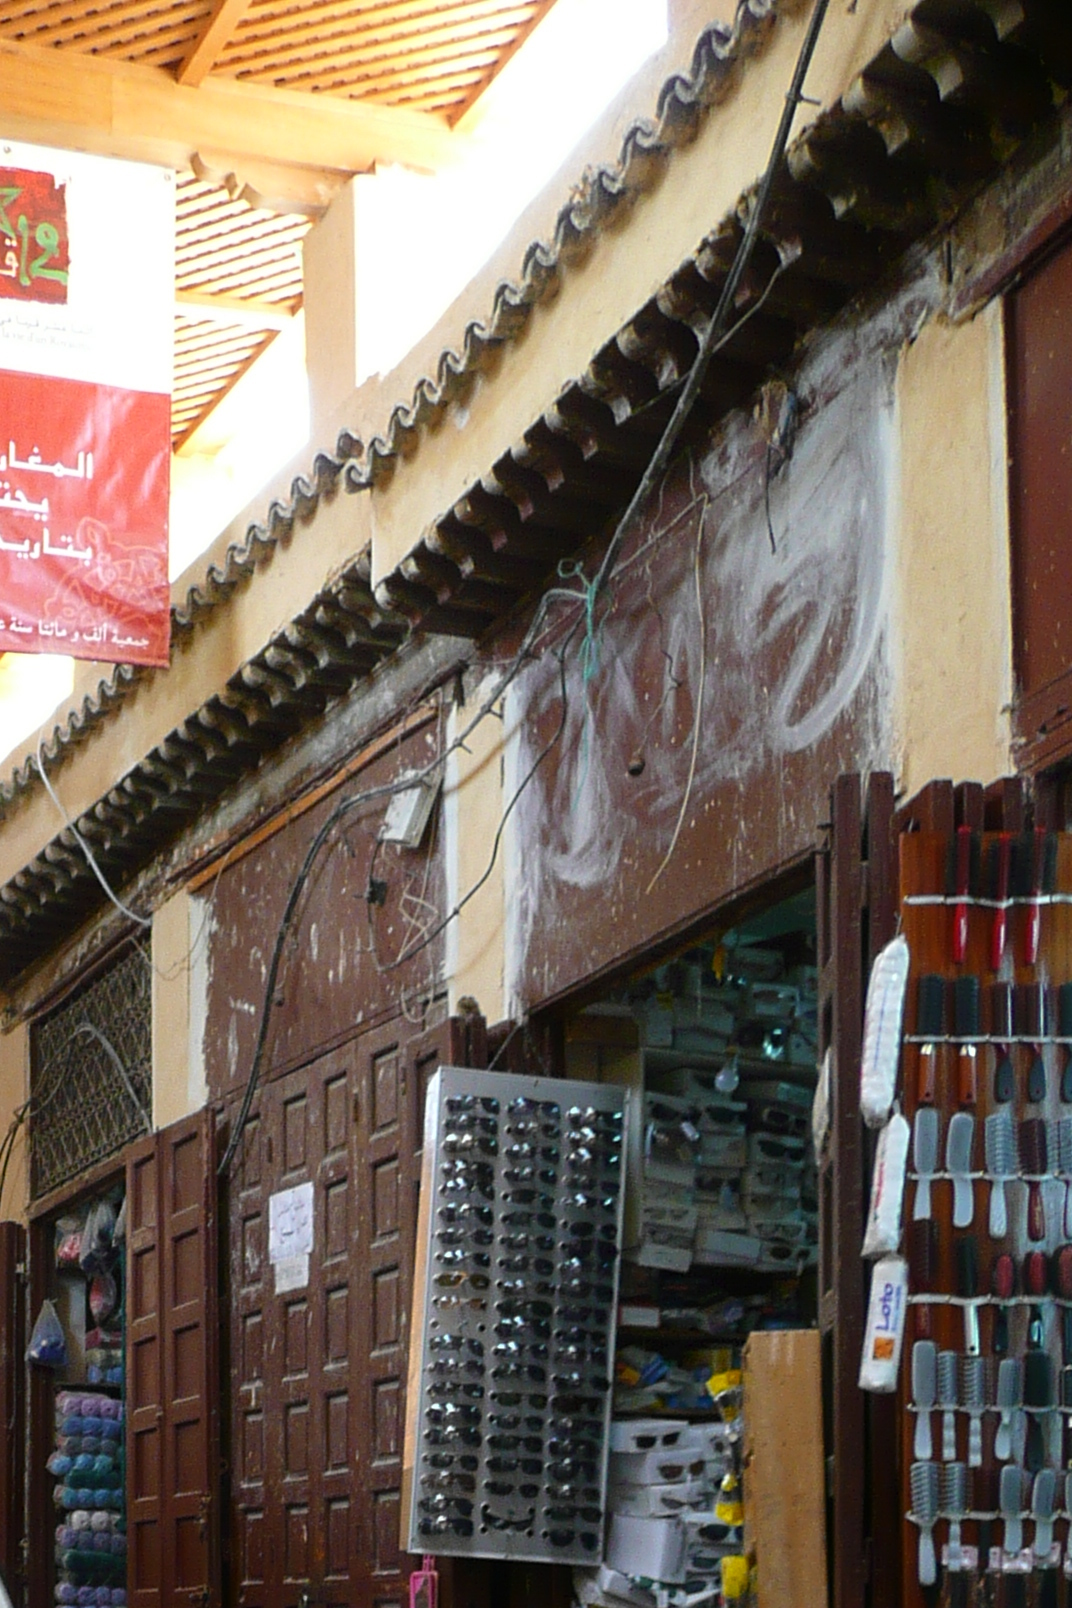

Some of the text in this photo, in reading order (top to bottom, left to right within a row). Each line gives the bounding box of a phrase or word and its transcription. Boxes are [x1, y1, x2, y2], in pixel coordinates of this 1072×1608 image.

[9, 617, 33, 635] سنة
[82, 623, 108, 643] ألف
[70, 632, 79, 643] و
[111, 628, 150, 649] جمعية
